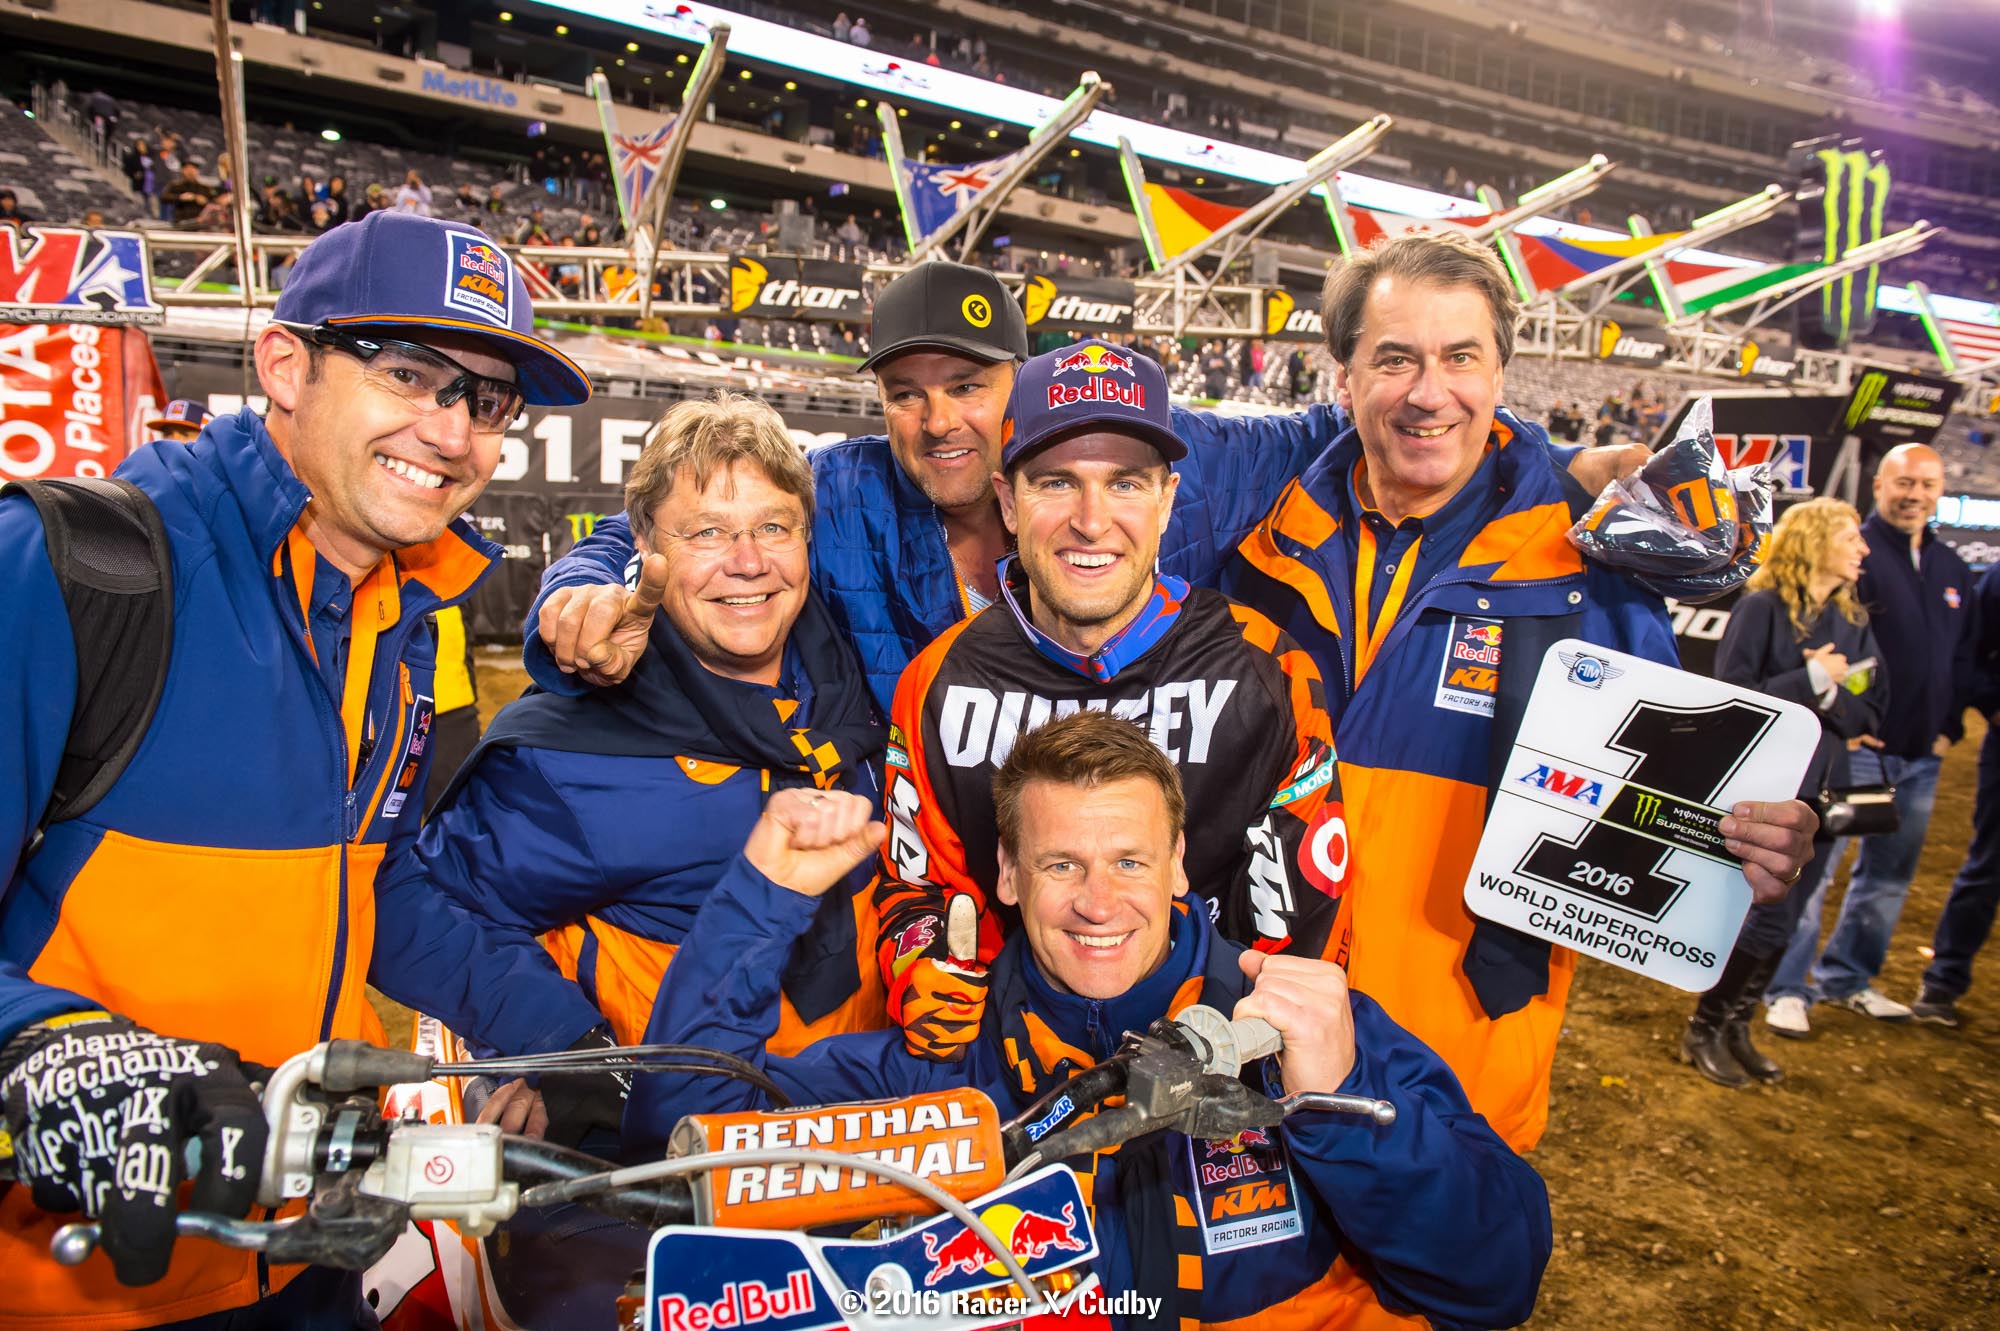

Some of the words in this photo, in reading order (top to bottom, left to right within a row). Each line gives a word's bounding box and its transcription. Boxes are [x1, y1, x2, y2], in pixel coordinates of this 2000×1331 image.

[460, 253, 487, 274] Red
[486, 262, 505, 287] Bull
[458, 273, 505, 304] KTM
[759, 279, 860, 310] thor
[1048, 295, 1133, 324] thor
[1047, 376, 1099, 410] Red
[1100, 377, 1145, 411] Bull
[1454, 641, 1490, 663] Red
[1576, 662, 1601, 680] FIM
[1443, 693, 1482, 707] FACTORY
[939, 679, 1238, 770] DUEY
[1517, 763, 1604, 808] AMA
[1513, 698, 1783, 924] 1
[1673, 807, 1720, 828] MONSTE
[1656, 818, 1726, 847] SUPERCROS
[1568, 860, 1635, 897] 2016
[1479, 872, 1558, 912] WORLD
[1562, 903, 1717, 969] SUPERCROSS
[1528, 911, 1649, 966] CHAMPION
[721, 1101, 980, 1152] RENTHAL
[725, 1138, 986, 1207] RENTHAL
[1201, 1155, 1242, 1185] Red
[1240, 1148, 1282, 1176] Bull
[1211, 1180, 1287, 1220] KTM
[1214, 1225, 1258, 1243] FACTORY
[1261, 1217, 1296, 1233] RACING
[660, 1286, 738, 1331] Red
[740, 1271, 814, 1323] Bull
